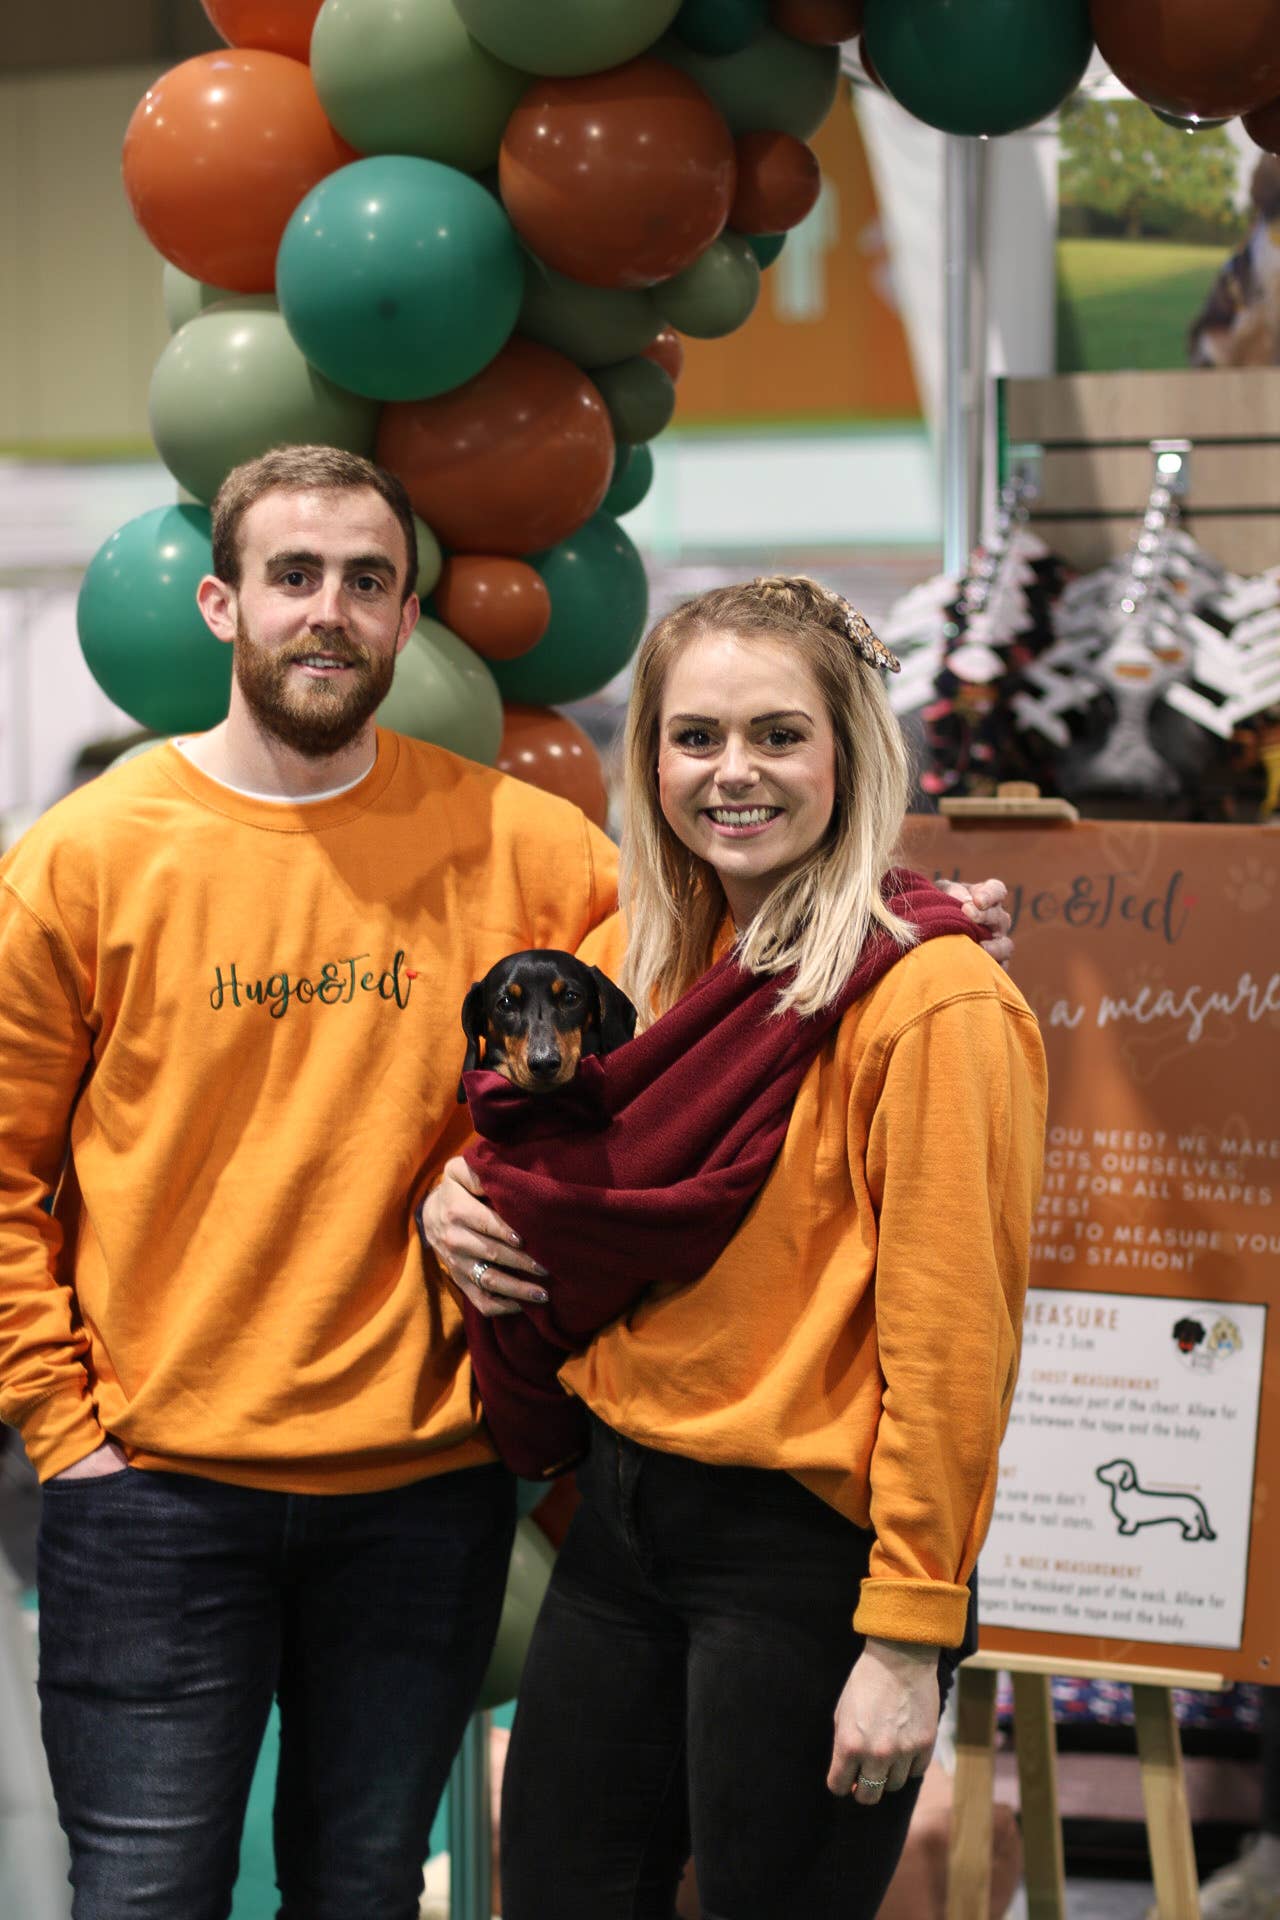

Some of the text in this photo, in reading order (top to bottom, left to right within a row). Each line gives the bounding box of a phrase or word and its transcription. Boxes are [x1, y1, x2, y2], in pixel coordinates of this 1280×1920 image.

[209, 949, 415, 1019] Hugo&Ted
[1051, 998, 1085, 1029] a
[1093, 1128, 1167, 1153] NEED?
[1178, 1133, 1207, 1154] WE
[1220, 1138, 1280, 1158] MAKE
[1076, 1174, 1124, 1195] FOR
[1132, 1179, 1171, 1200] ALL
[1182, 1182, 1272, 1206] SHAPES
[1075, 1221, 1104, 1242] TO
[1113, 1225, 1222, 1250] MEASURE
